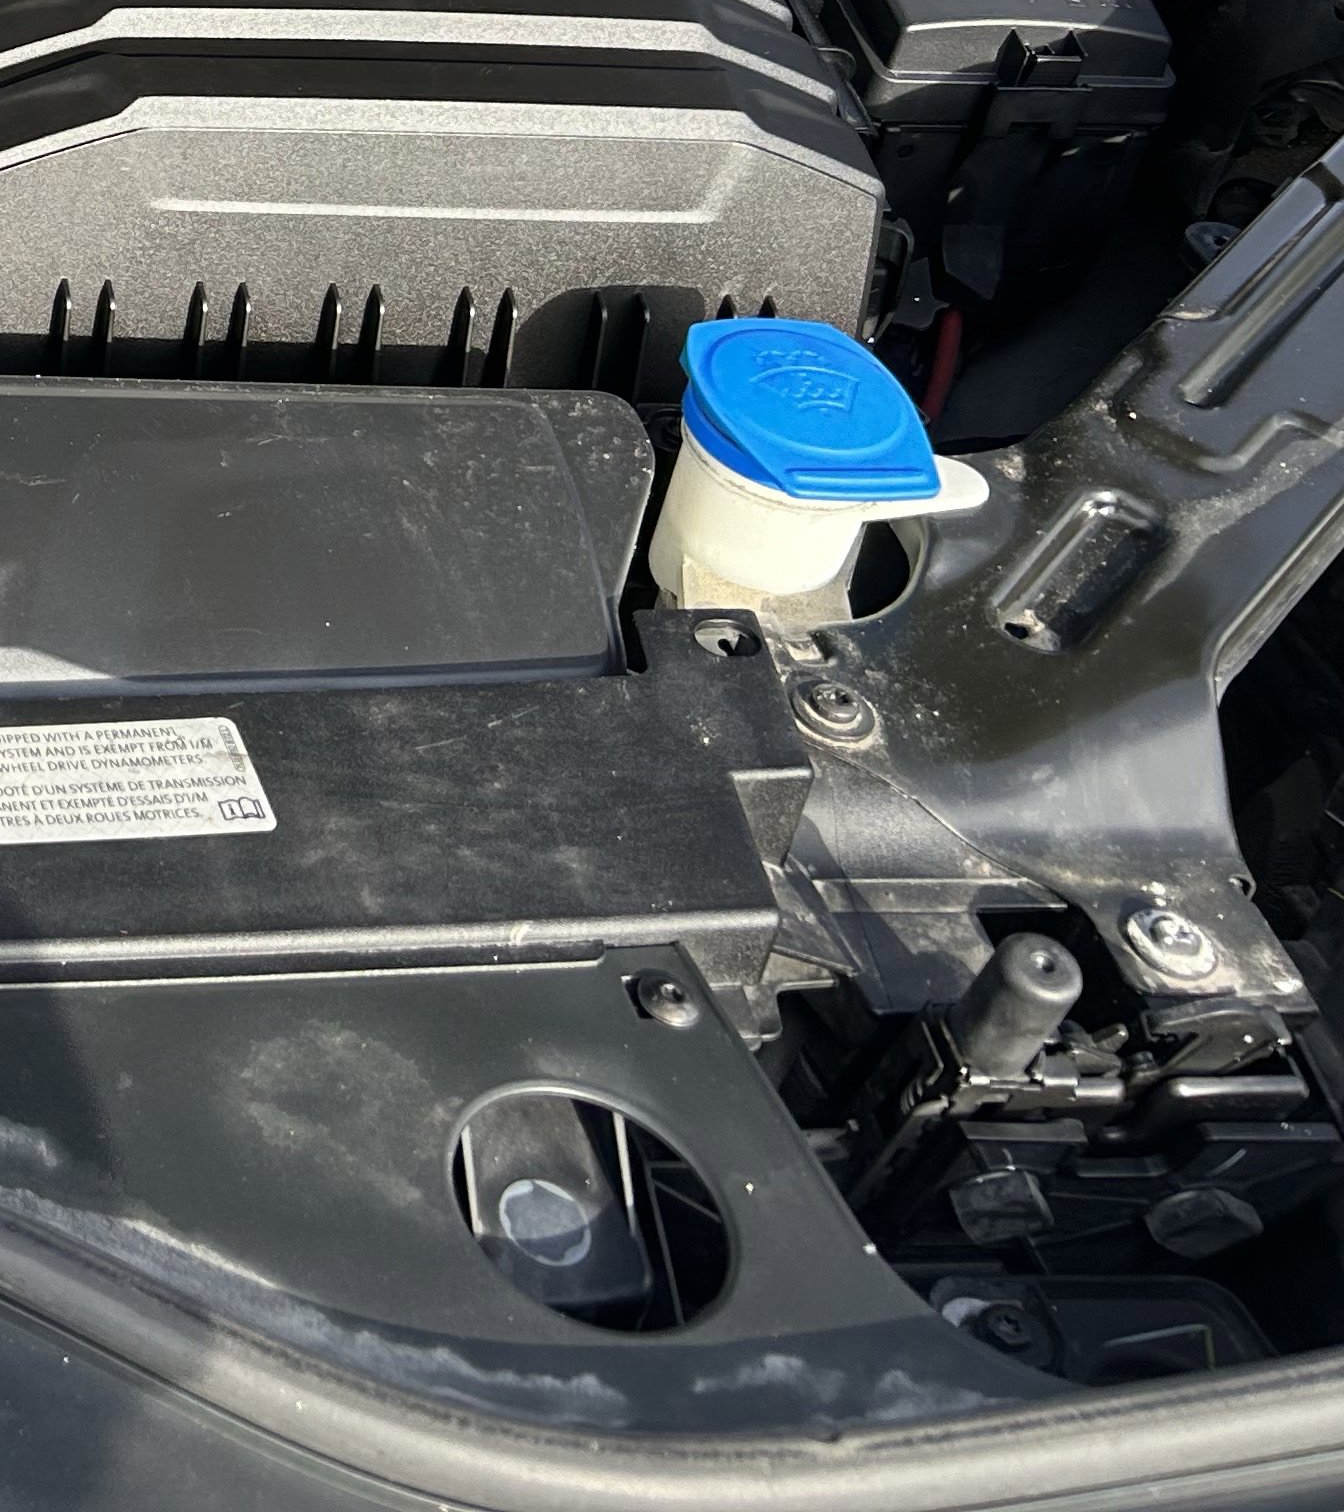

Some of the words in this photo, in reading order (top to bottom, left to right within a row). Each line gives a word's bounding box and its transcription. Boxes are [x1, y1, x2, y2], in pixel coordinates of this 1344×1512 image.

[43, 731, 81, 743] WITH
[84, 731, 94, 741] A
[100, 727, 177, 740] PERMANENT
[46, 746, 75, 757] AND
[80, 745, 91, 755] IS
[95, 742, 145, 754] EXEMPT
[150, 739, 187, 751] FROM
[189, 737, 213, 750] I/M
[47, 759, 87, 771] DRIVE
[32, 784, 66, 795] D'UN
[128, 780, 146, 791] DE
[149, 776, 247, 789] TRANSMISSION
[41, 799, 54, 810] ET
[58, 793, 115, 810] EXEMPTÉ
[118, 793, 171, 807] D'ESSAIS
[34, 812, 43, 825] À
[46, 813, 83, 824] DEUX
[86, 810, 131, 823] ROUES
[134, 807, 202, 822] MOTRICES.
